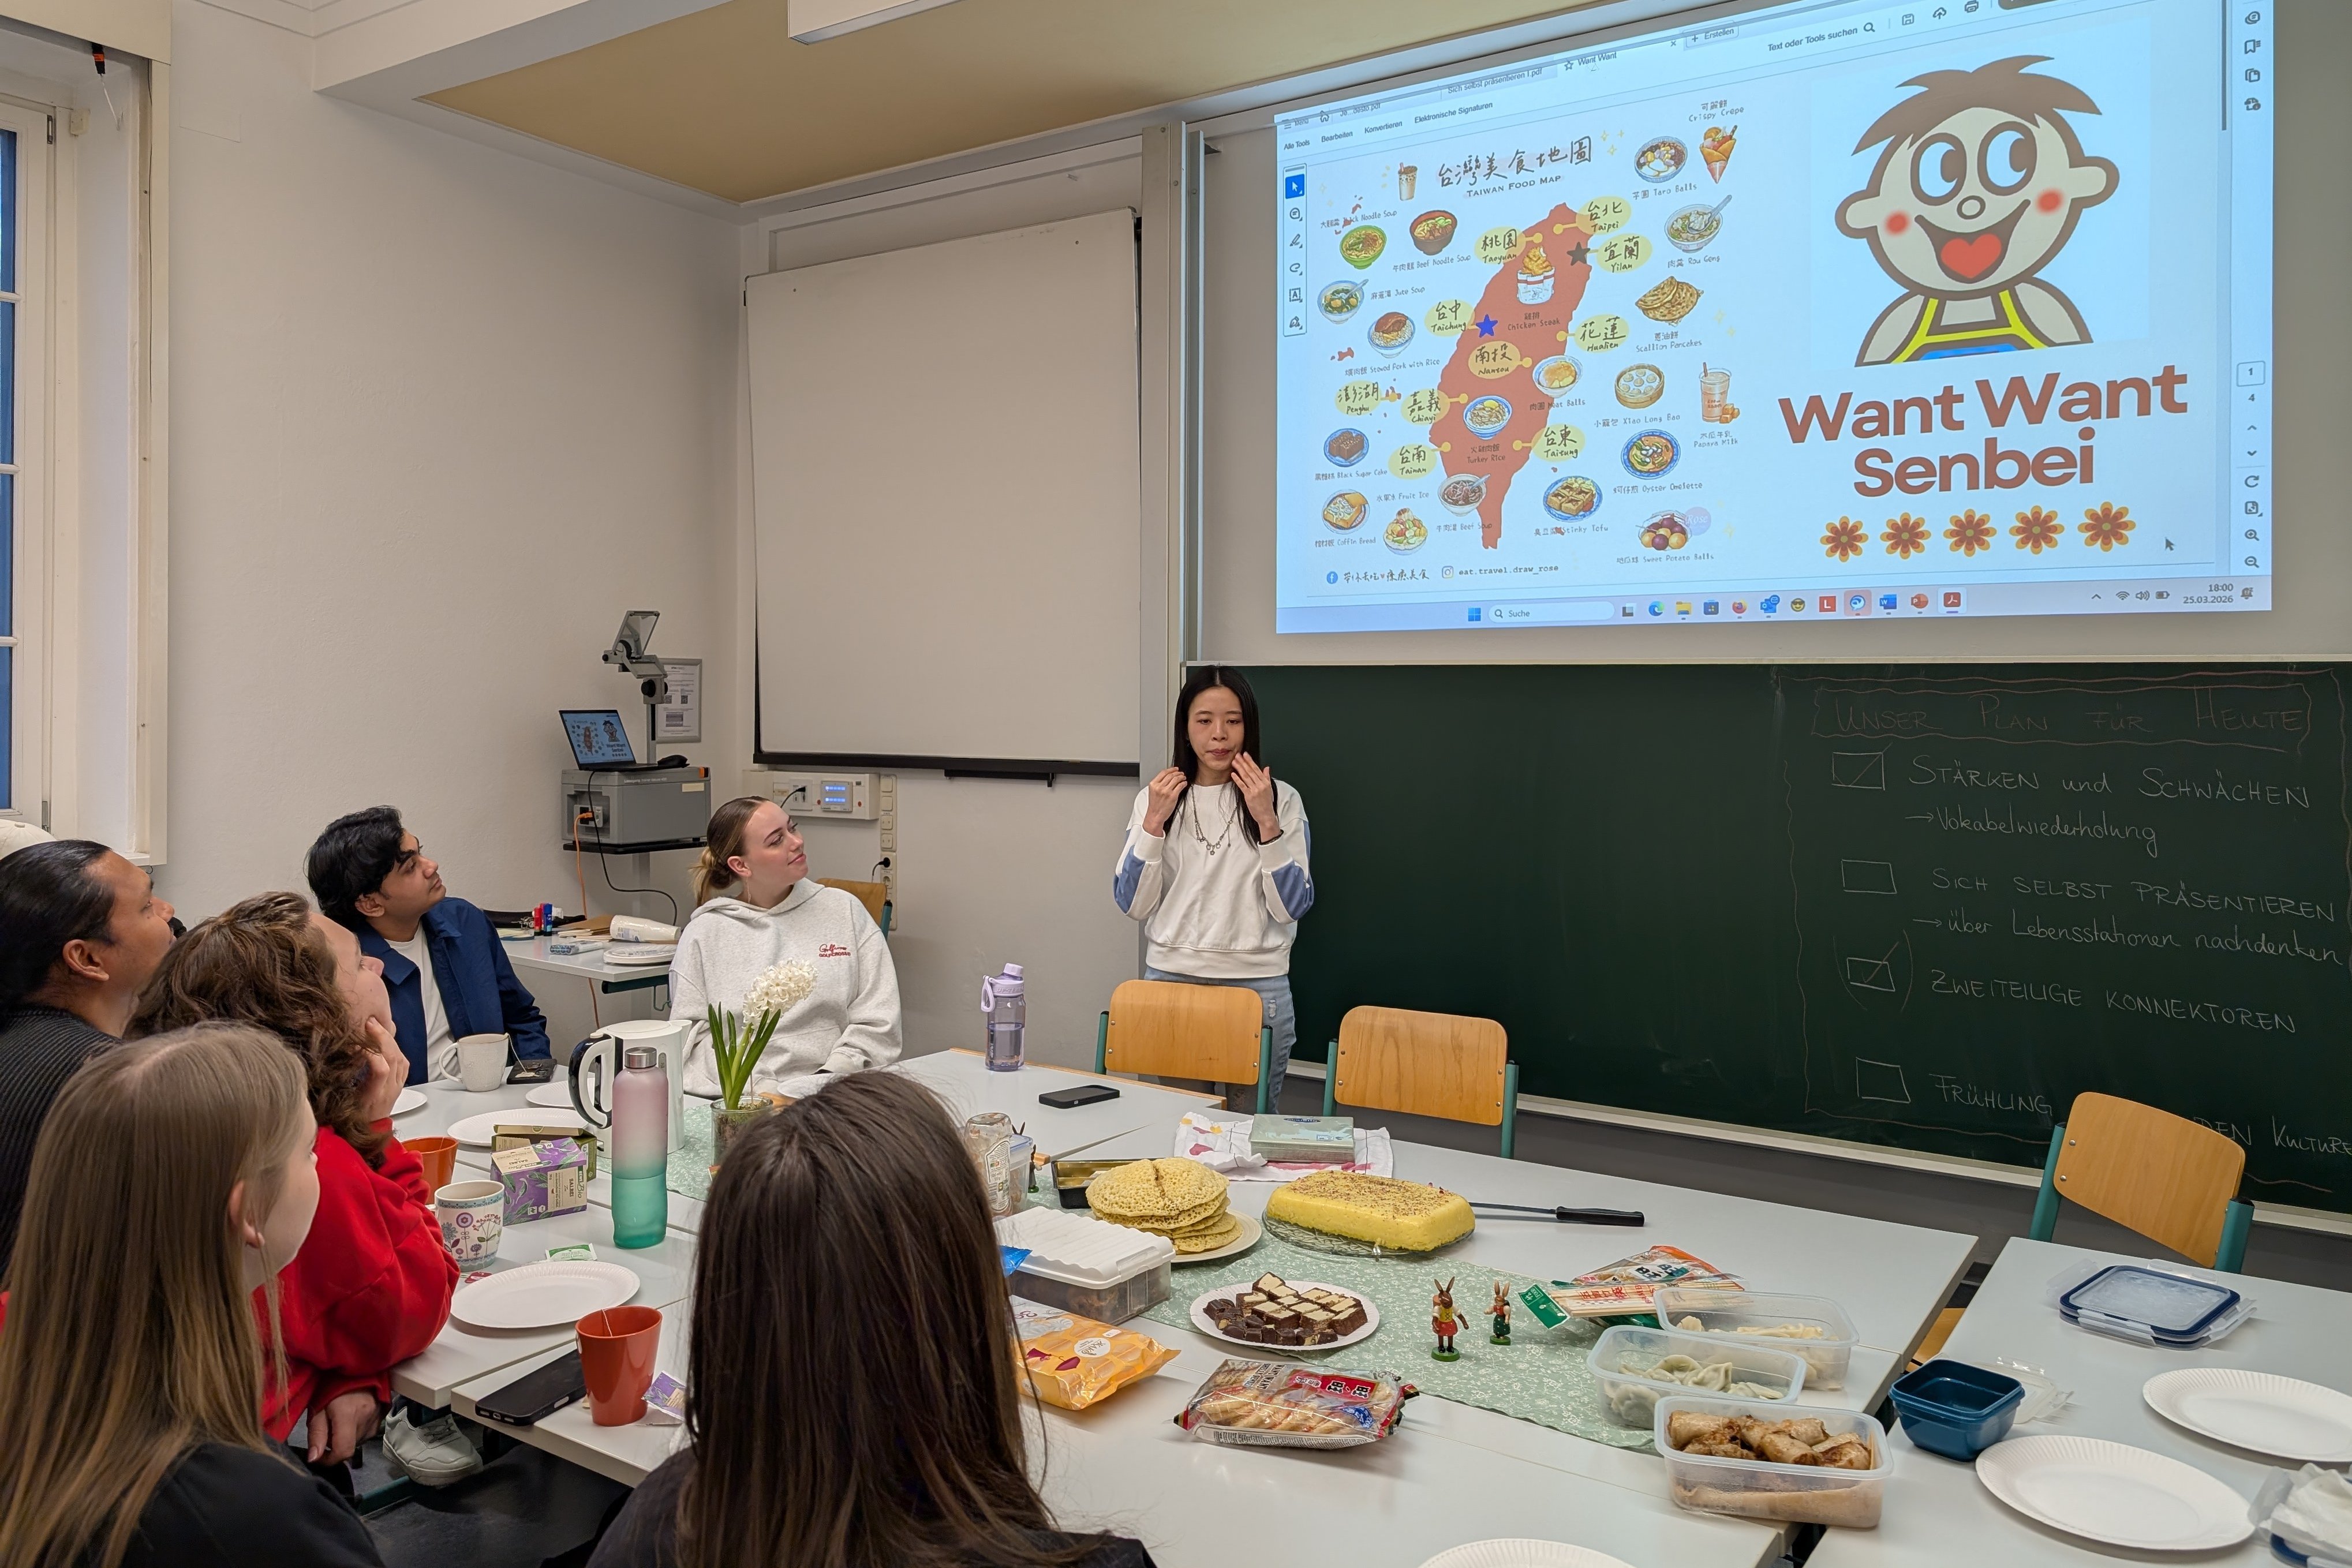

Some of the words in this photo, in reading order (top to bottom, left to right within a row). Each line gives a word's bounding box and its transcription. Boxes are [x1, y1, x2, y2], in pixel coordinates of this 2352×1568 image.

[1704, 28, 1734, 40] Erstellen
[1768, 43, 1783, 51] Text
[1785, 39, 1803, 48] oder
[1805, 33, 1826, 44] Tools
[1827, 28, 1858, 39] suchen
[1577, 56, 1596, 66] Want
[1598, 51, 1617, 62] Want
[1448, 84, 1463, 94] Sich
[1464, 80, 1482, 91] selbst
[1415, 108, 1457, 124] Elektronische
[1458, 102, 1493, 115] Signaturen
[1689, 113, 1717, 122] Crispy
[1721, 106, 1744, 117] Crepe
[1364, 120, 1403, 134] Konvertieren
[1321, 130, 1353, 143] Bearbeiten
[1284, 142, 1295, 151] Alle
[1296, 139, 1310, 148] Tools
[1438, 135, 1592, 188] 台灣美食地圖
[1508, 178, 1535, 190] FOOD
[1539, 175, 1561, 185] MAP
[1653, 188, 1672, 196] Taro
[1675, 182, 1698, 193] Balls
[1361, 212, 1381, 222] Noodle
[1383, 209, 1398, 220] Soup
[1587, 201, 1623, 222] 台北
[1591, 220, 1620, 233] Taipei
[1481, 229, 1517, 252] 桃園
[1604, 235, 1640, 263] 宜蘭
[1392, 262, 1415, 273] 牛肉麵
[1416, 260, 1430, 269] Beef
[1432, 256, 1454, 267] Noodle
[1456, 255, 1471, 264] Soup
[1482, 252, 1517, 265] Taoyuan
[1688, 257, 1702, 265] Rou
[1611, 263, 1633, 273] Yilan
[1394, 287, 1409, 297] Jute
[1411, 286, 1426, 295] Soup
[1435, 299, 1461, 321] 台中
[1430, 321, 1467, 333] Taichung
[1507, 321, 1536, 331] Chicken
[1539, 317, 1561, 327] Steak
[1579, 316, 1626, 342] 花蓮
[1587, 342, 1619, 352] Hualien
[1636, 342, 1667, 353] Scallion
[1670, 339, 1702, 349] Pancakes
[1475, 343, 1513, 365] 南投
[1370, 364, 1390, 373] Stewed
[1392, 362, 1407, 371] Pork
[1408, 360, 1423, 368] with
[1425, 358, 1440, 366] Rice
[1478, 366, 1509, 376] Nantou
[2249, 368, 2254, 376] 1
[1337, 381, 1380, 403] 澎湖
[2248, 394, 2256, 402] 4
[1407, 388, 1442, 417] 嘉義
[1547, 401, 1564, 409] Meat
[1566, 398, 1586, 407] Balls
[1778, 385, 1964, 444] Want
[1975, 365, 2188, 428] Want
[1346, 405, 1370, 416] Penghu
[1411, 413, 1437, 424] Chiayi
[1622, 416, 1641, 425] Xiao
[1644, 415, 1663, 424] Long
[1666, 413, 1681, 421] Bao
[1543, 424, 1577, 447] 台東
[1693, 439, 1719, 448] Papaya
[1721, 437, 1738, 446] Milk
[1399, 444, 1427, 465] 台南
[1467, 455, 1489, 464] Turkey
[1491, 454, 1506, 462] Rice
[1543, 447, 1579, 458] Taitung
[1853, 426, 2096, 497] Senbei
[1337, 471, 1353, 479] Black
[1355, 470, 1372, 478] Sugar
[1374, 468, 1388, 476] Cake
[1399, 466, 1427, 476] Tainan
[1642, 484, 1666, 493] Oyster
[1670, 481, 1703, 491] Omelette
[1398, 492, 1416, 500] Fruit
[1419, 491, 1429, 499] Ice
[1460, 522, 1474, 530] Beef
[1478, 521, 1493, 530] Soup
[1591, 523, 1609, 532] Tofu
[1337, 537, 1357, 546] Coffin
[1359, 536, 1377, 545] Bread
[1643, 555, 1662, 563] Sweet
[1666, 553, 1691, 562] Potato
[1693, 551, 1714, 560] Balls
[1459, 564, 1559, 575] eat.travel.draw_rose
[2208, 583, 2234, 593] 18:00
[2183, 595, 2234, 605] 25.03.2026
[1508, 609, 1530, 618] Suche
[1909, 754, 2040, 791] STÄRKEN
[2062, 773, 2112, 795] und
[2138, 767, 2310, 810] SCHWÄCHEN
[1935, 805, 2159, 859] Vokabelwiederholung
[1932, 868, 1989, 892] SICH
[2013, 876, 2114, 900] SELBST
[2130, 880, 2335, 923] PRÄSENTIEREN
[1949, 908, 1994, 934] über
[2012, 908, 2182, 948] Lebensstationen
[2194, 925, 2344, 966] nachdenken
[1931, 969, 2082, 1007] ZWEITEILIGE
[2106, 990, 2297, 1034] KONNEKTOREN
[1928, 1073, 2054, 1116] FRÜHLING
